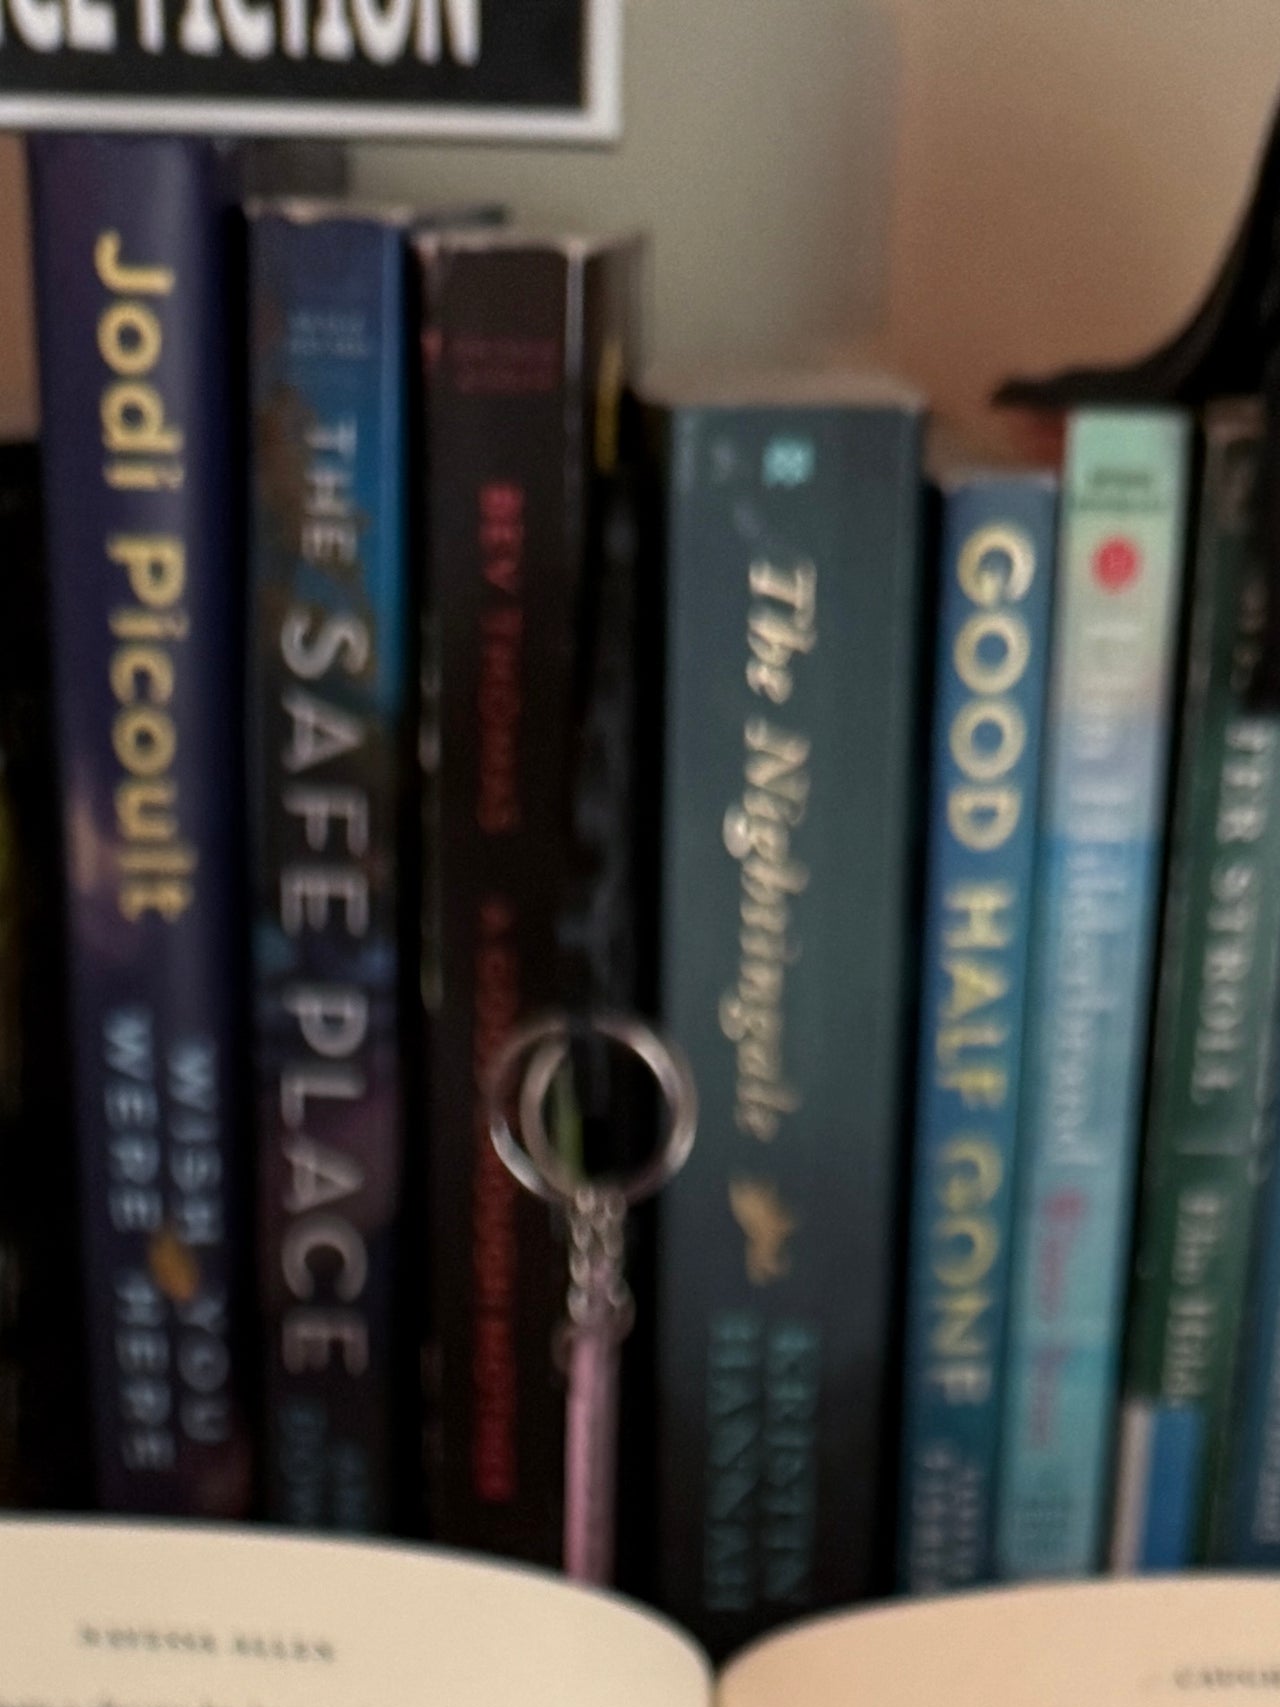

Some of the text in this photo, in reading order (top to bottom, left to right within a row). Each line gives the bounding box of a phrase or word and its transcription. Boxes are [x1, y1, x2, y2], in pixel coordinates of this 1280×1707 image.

[87, 227, 201, 924] Jodi Picoult
[296, 411, 359, 566] THE
[274, 607, 371, 940] SAFE
[710, 557, 817, 1145] The Nightingale
[943, 521, 1032, 855] GOOD
[931, 877, 1015, 1115] HALF
[1189, 864, 1257, 1107] STROLL
[98, 1008, 171, 1473] WERE HERE
[162, 1035, 235, 1447] WISH YOU
[277, 984, 372, 1379] PLACE
[920, 1136, 1004, 1407] GONE
